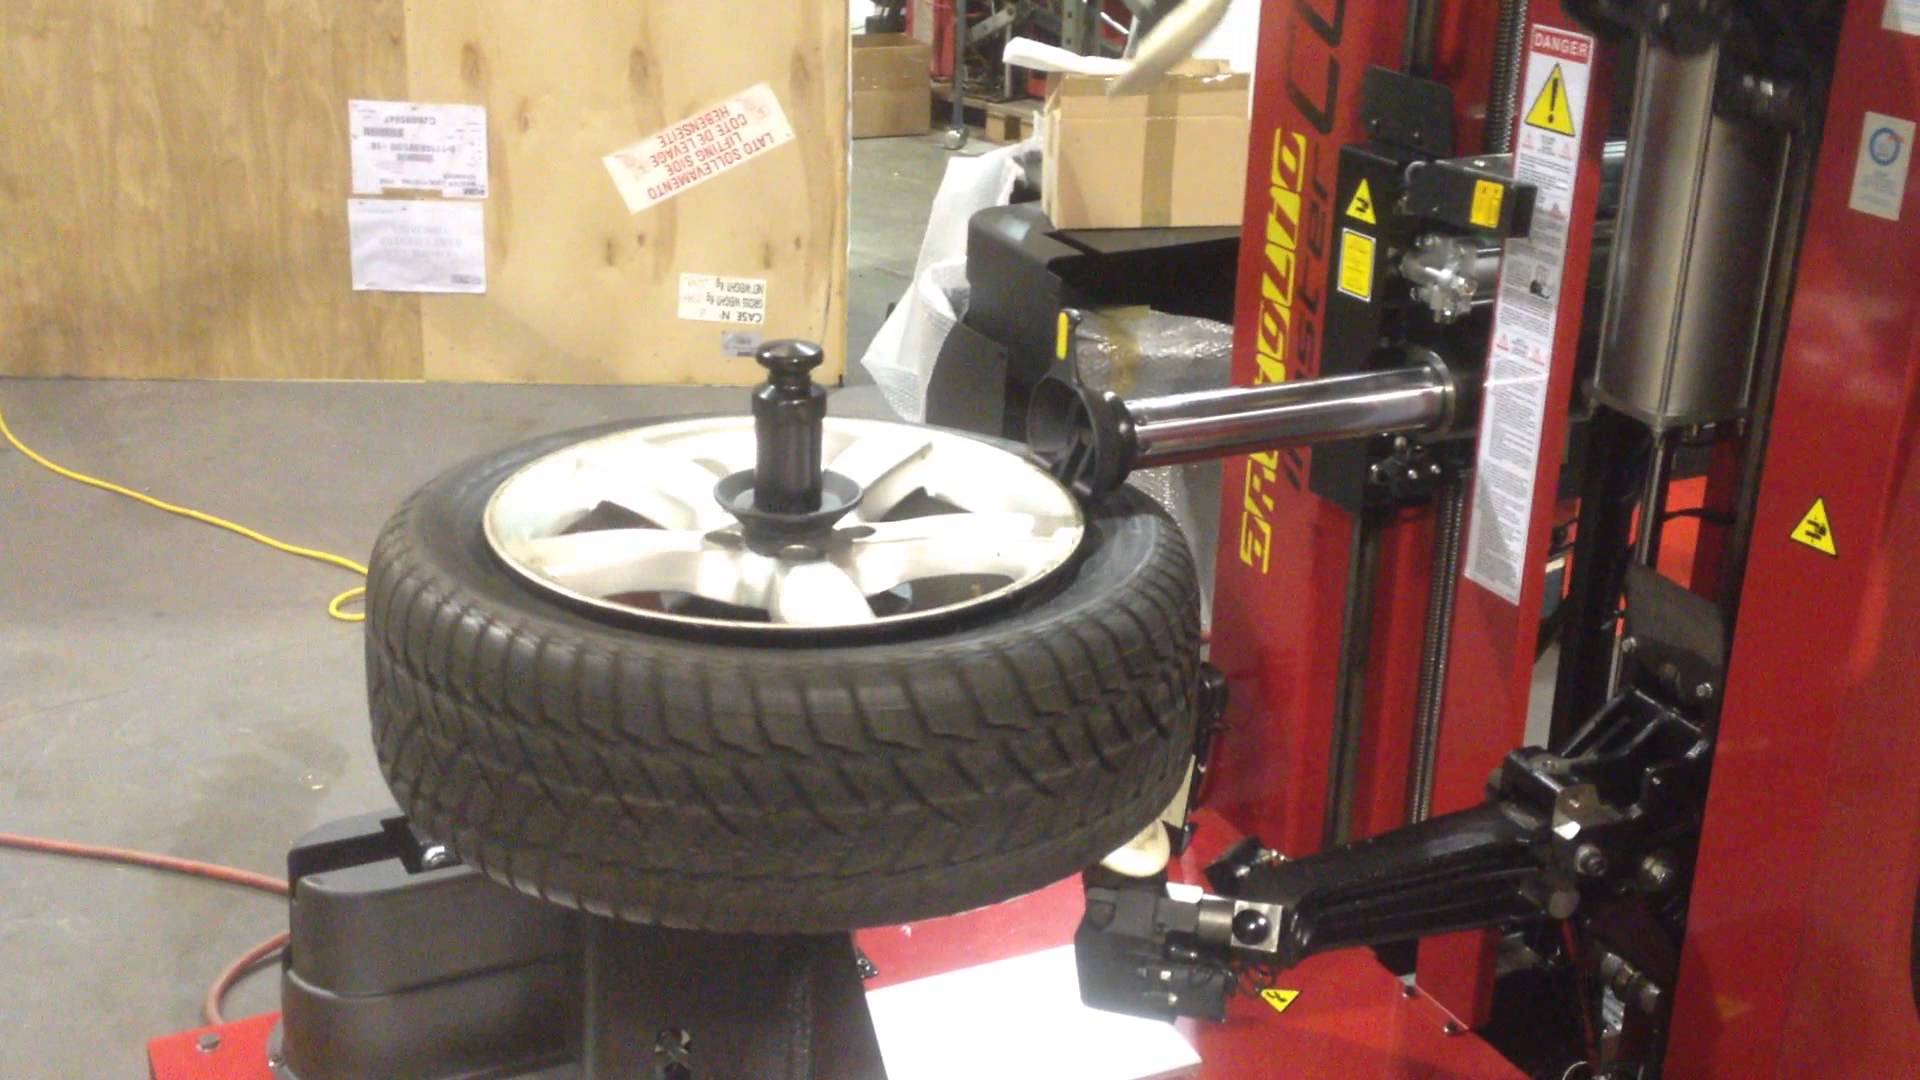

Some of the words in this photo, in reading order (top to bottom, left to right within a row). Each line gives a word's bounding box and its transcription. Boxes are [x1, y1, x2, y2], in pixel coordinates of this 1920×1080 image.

[1534, 32, 1589, 57] DANGER
[657, 105, 730, 148] HEBENSEITE
[718, 113, 748, 132] COTE
[695, 131, 743, 162] LIFTING
[698, 129, 714, 143] DE
[744, 132, 775, 155] LATO
[650, 140, 696, 168] LEVAGE
[666, 154, 694, 176] SIDE
[647, 147, 742, 200] SOLLEVAMENTO
[737, 311, 762, 323] CASE
